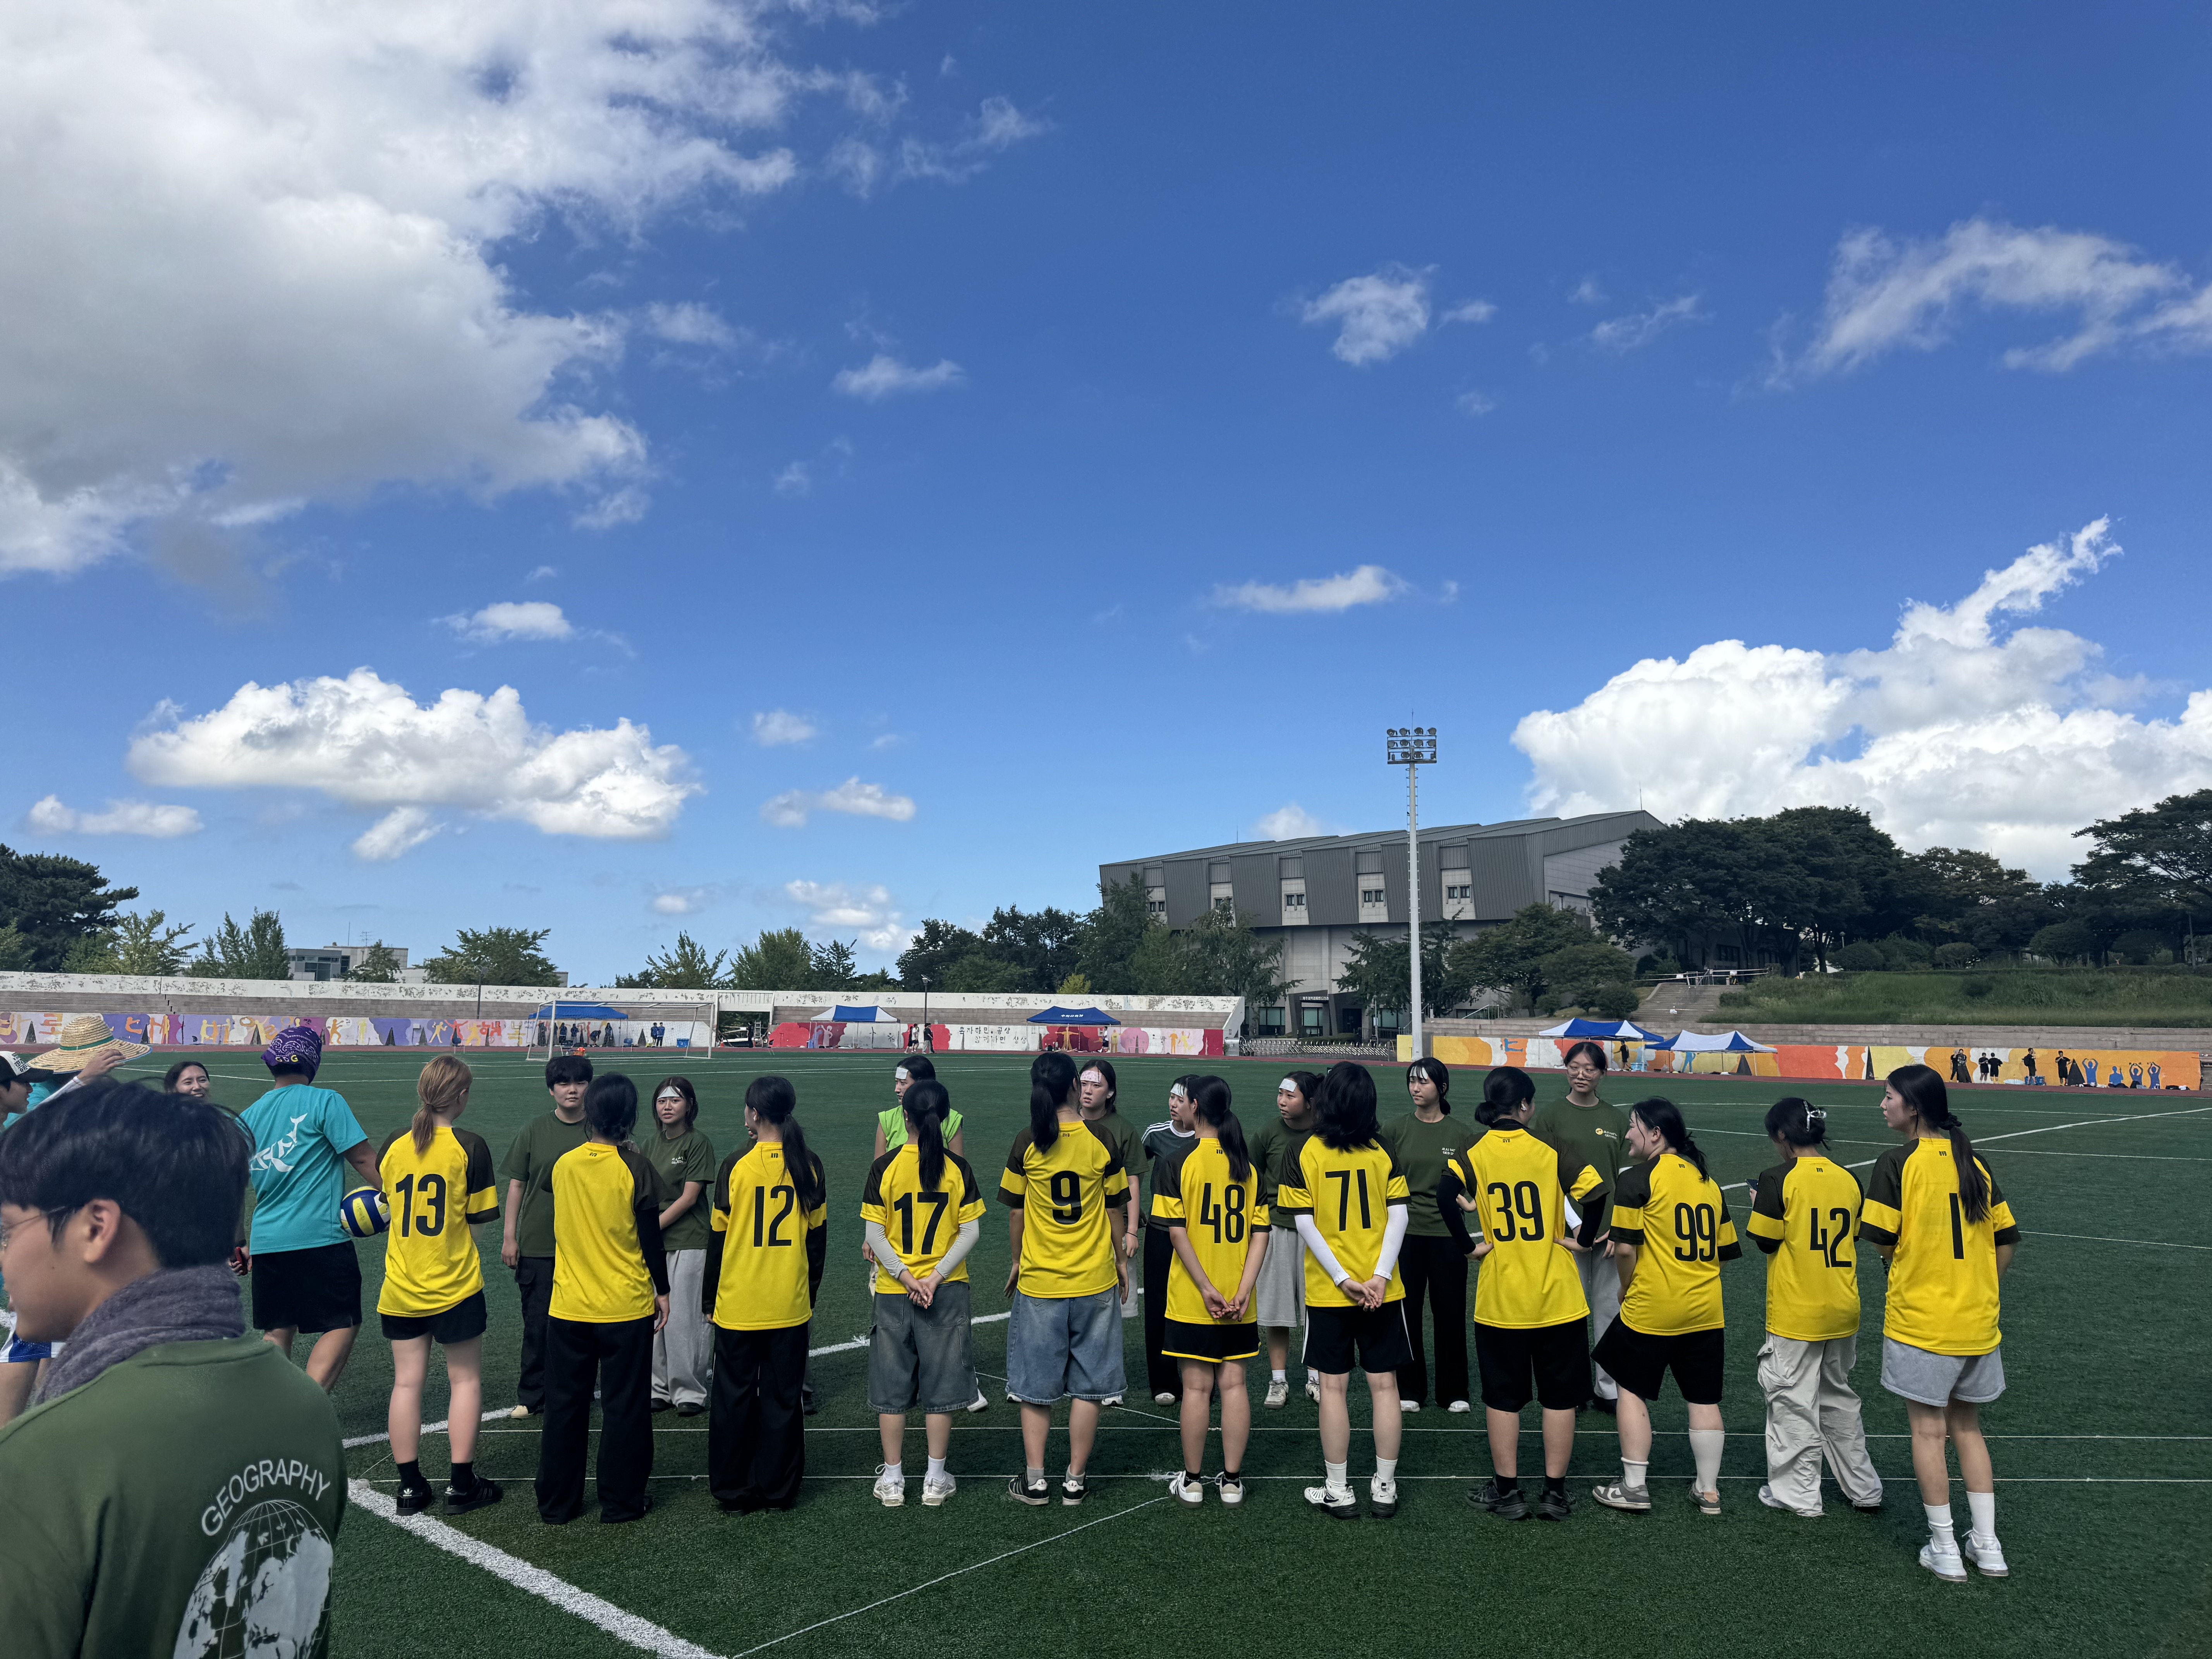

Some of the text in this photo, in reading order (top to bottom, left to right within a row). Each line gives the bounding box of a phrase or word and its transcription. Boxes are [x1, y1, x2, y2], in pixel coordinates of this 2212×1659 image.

[396, 1174, 446, 1237] 13
[754, 1185, 795, 1247] 12
[894, 1192, 949, 1255] 17
[1050, 1170, 1083, 1225] 9
[1200, 1183, 1245, 1243] 48
[1325, 1169, 1371, 1231] 71
[1487, 1181, 1544, 1242] 39
[1949, 1193, 1964, 1259] 1
[1674, 1202, 1716, 1262] 99
[1810, 1207, 1852, 1268] 42
[201, 1458, 331, 1536] GEOGRAPHY
